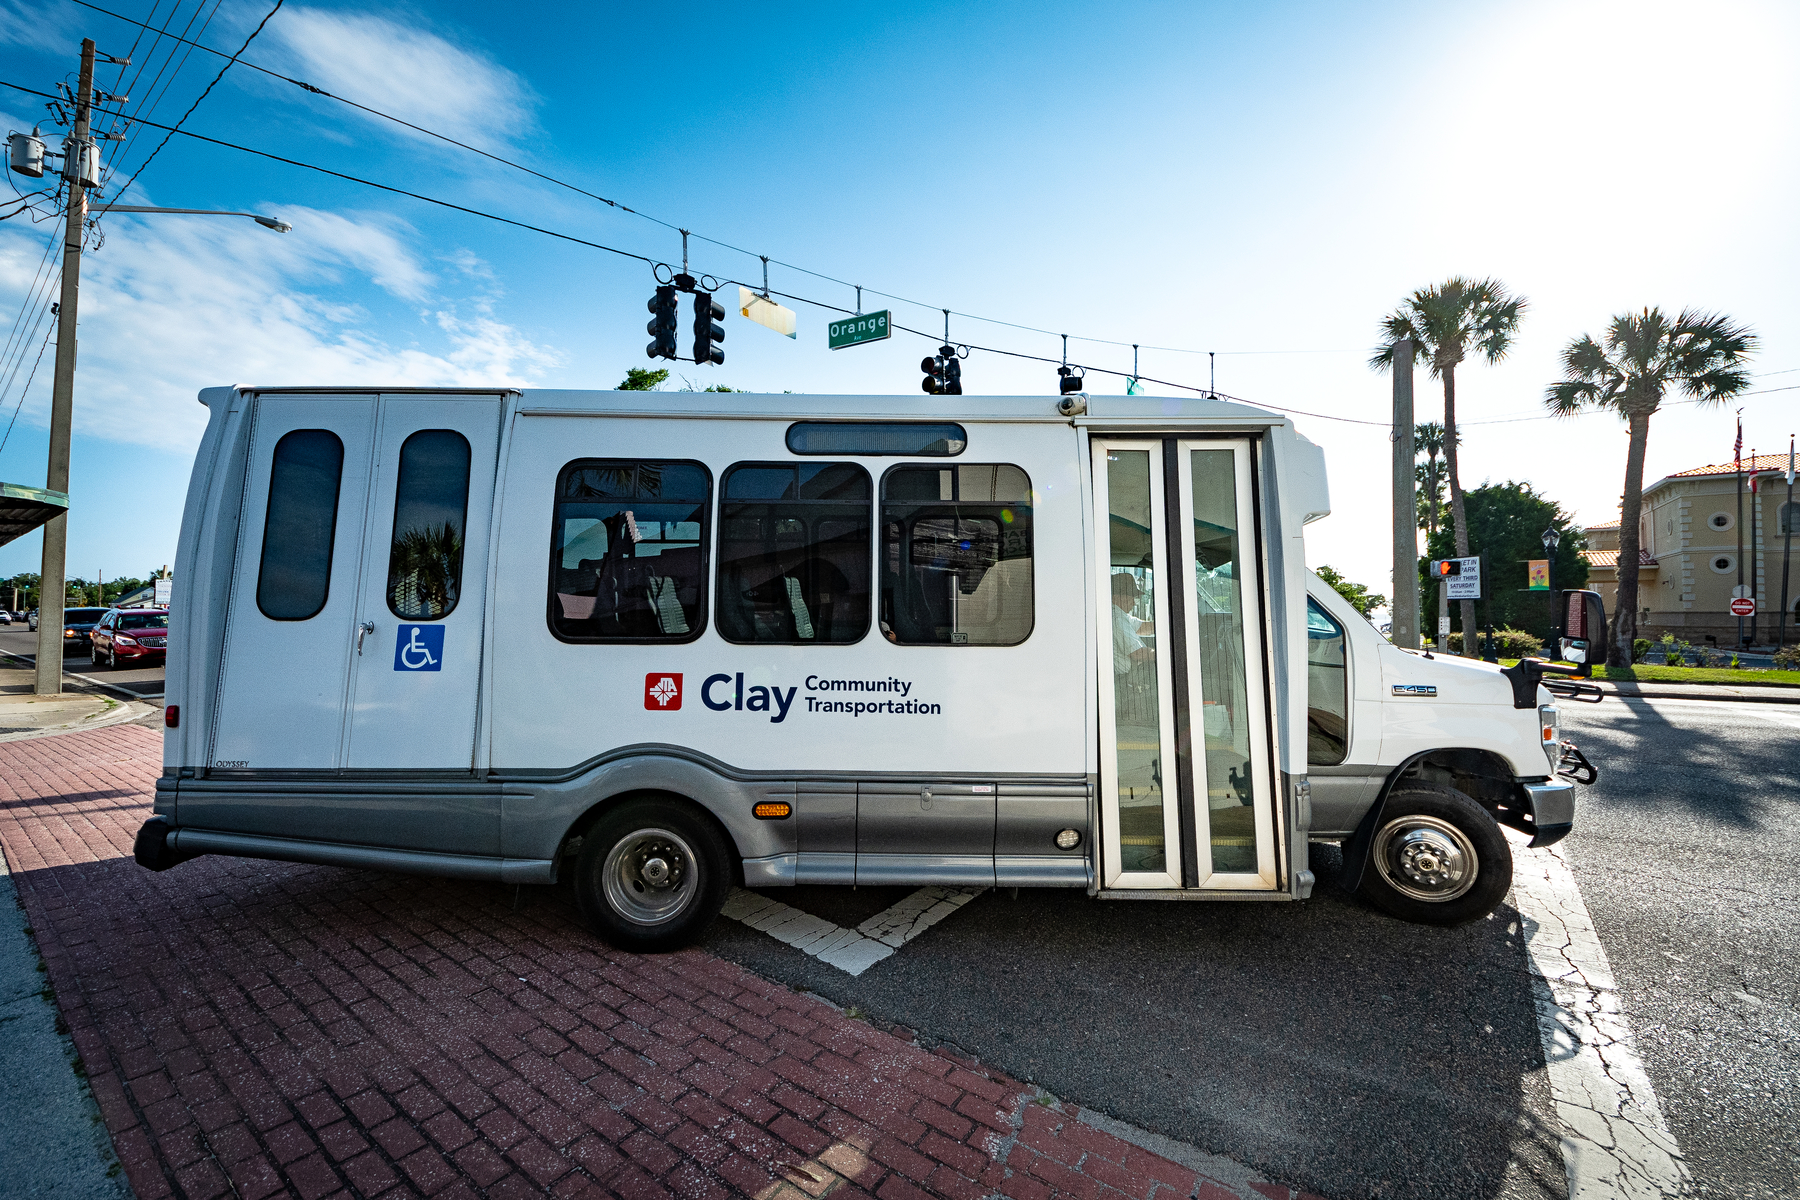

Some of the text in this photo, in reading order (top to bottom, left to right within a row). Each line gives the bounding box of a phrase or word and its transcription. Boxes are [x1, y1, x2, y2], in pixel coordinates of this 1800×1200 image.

[830, 316, 886, 337] Orange
[804, 675, 912, 697] Community
[700, 671, 798, 723] Clay
[804, 696, 941, 717] Transportation
[215, 760, 250, 768] ODYSSEY
